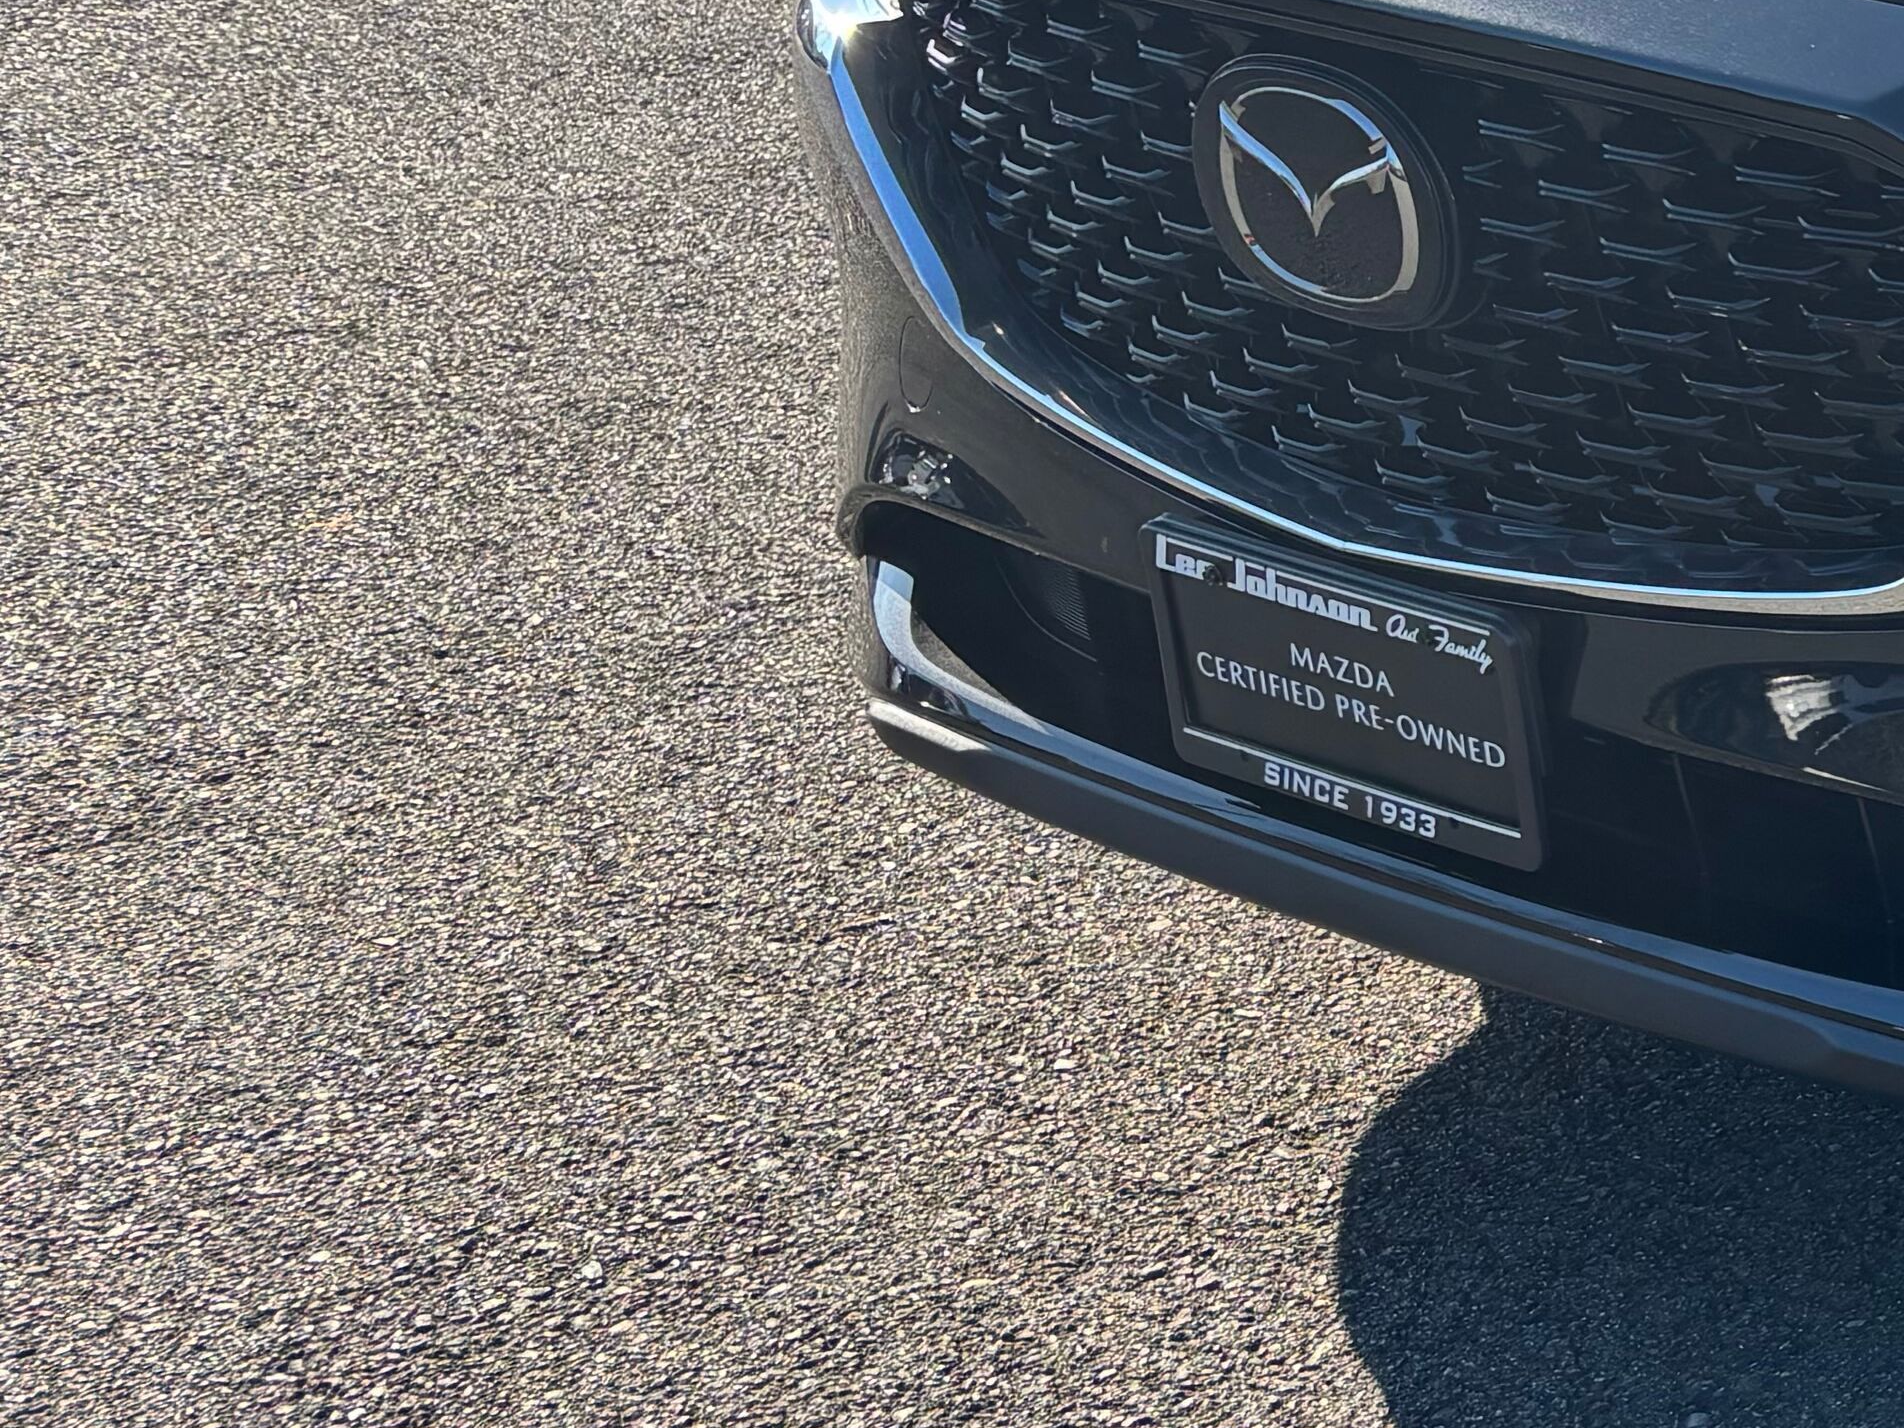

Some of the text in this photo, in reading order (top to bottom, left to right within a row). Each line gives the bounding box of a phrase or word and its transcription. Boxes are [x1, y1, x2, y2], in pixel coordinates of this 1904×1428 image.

[1227, 558, 1378, 632] Johnson
[1428, 625, 1493, 674] Family
[1196, 651, 1506, 768] CERTIFIED PRE-OWNED
[1289, 643, 1395, 697] MAZDA
[1263, 762, 1437, 838] SINCE 1933
